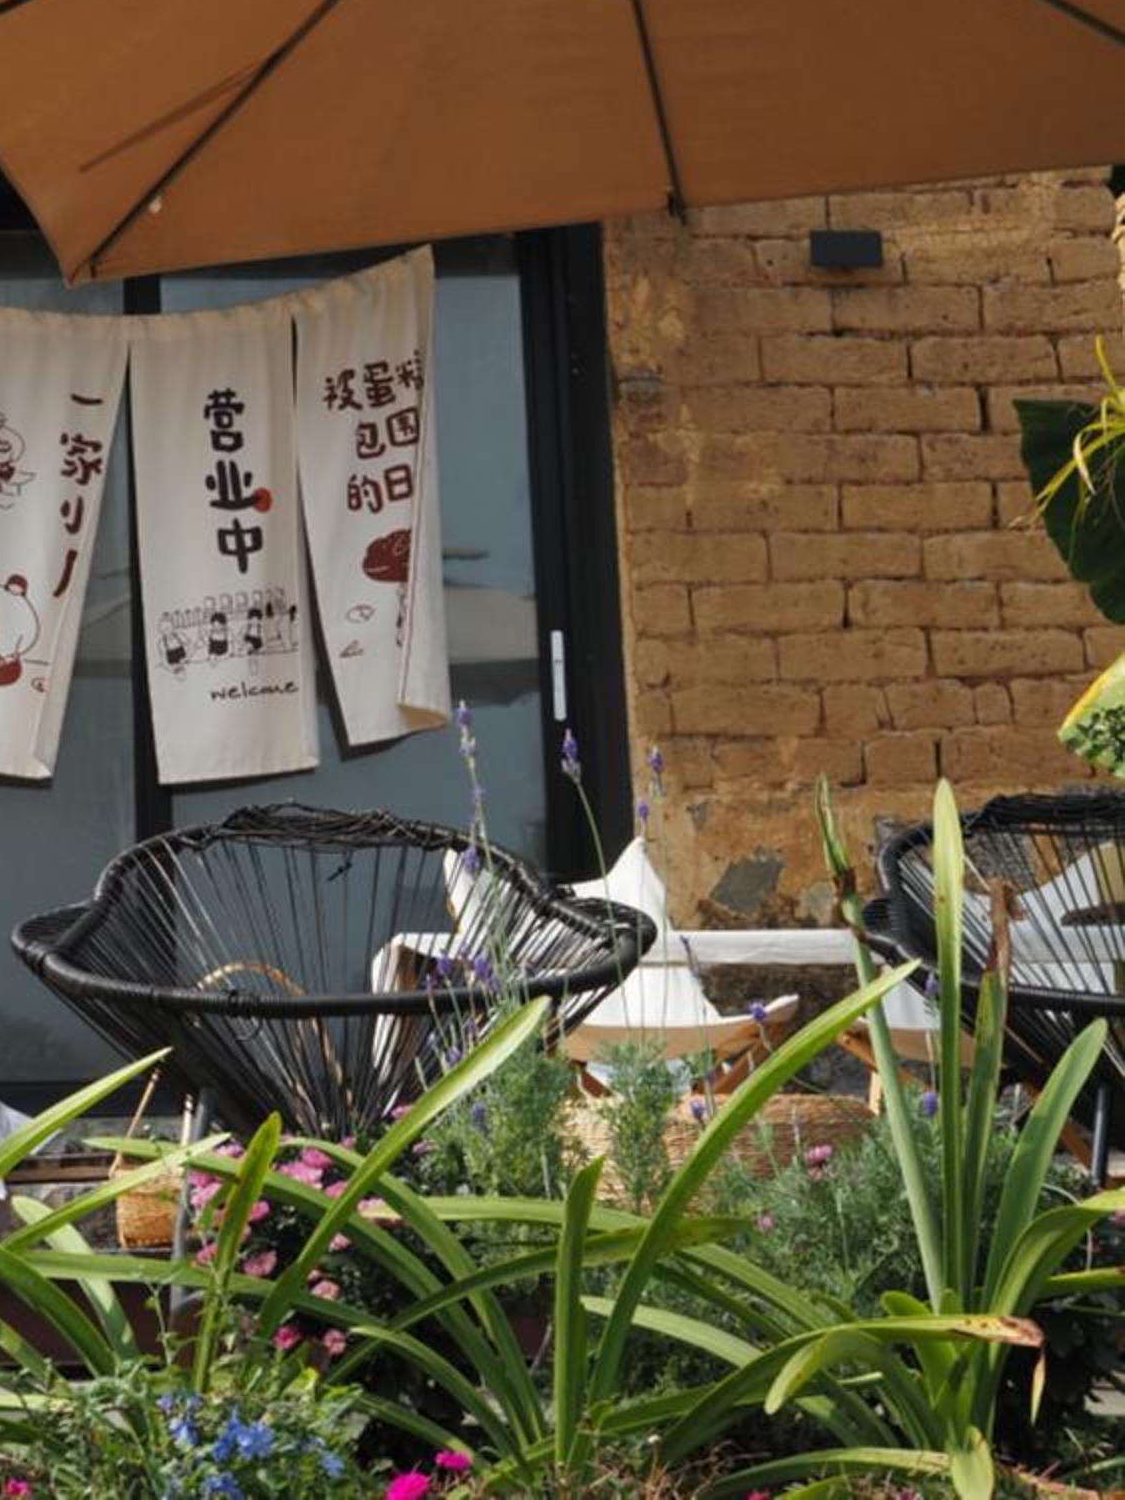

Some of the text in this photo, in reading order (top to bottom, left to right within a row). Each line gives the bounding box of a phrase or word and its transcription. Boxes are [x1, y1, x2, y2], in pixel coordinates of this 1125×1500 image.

[355, 407, 420, 460] 包围
[204, 388, 263, 575] 营业中
[210, 681, 300, 701] welcome
